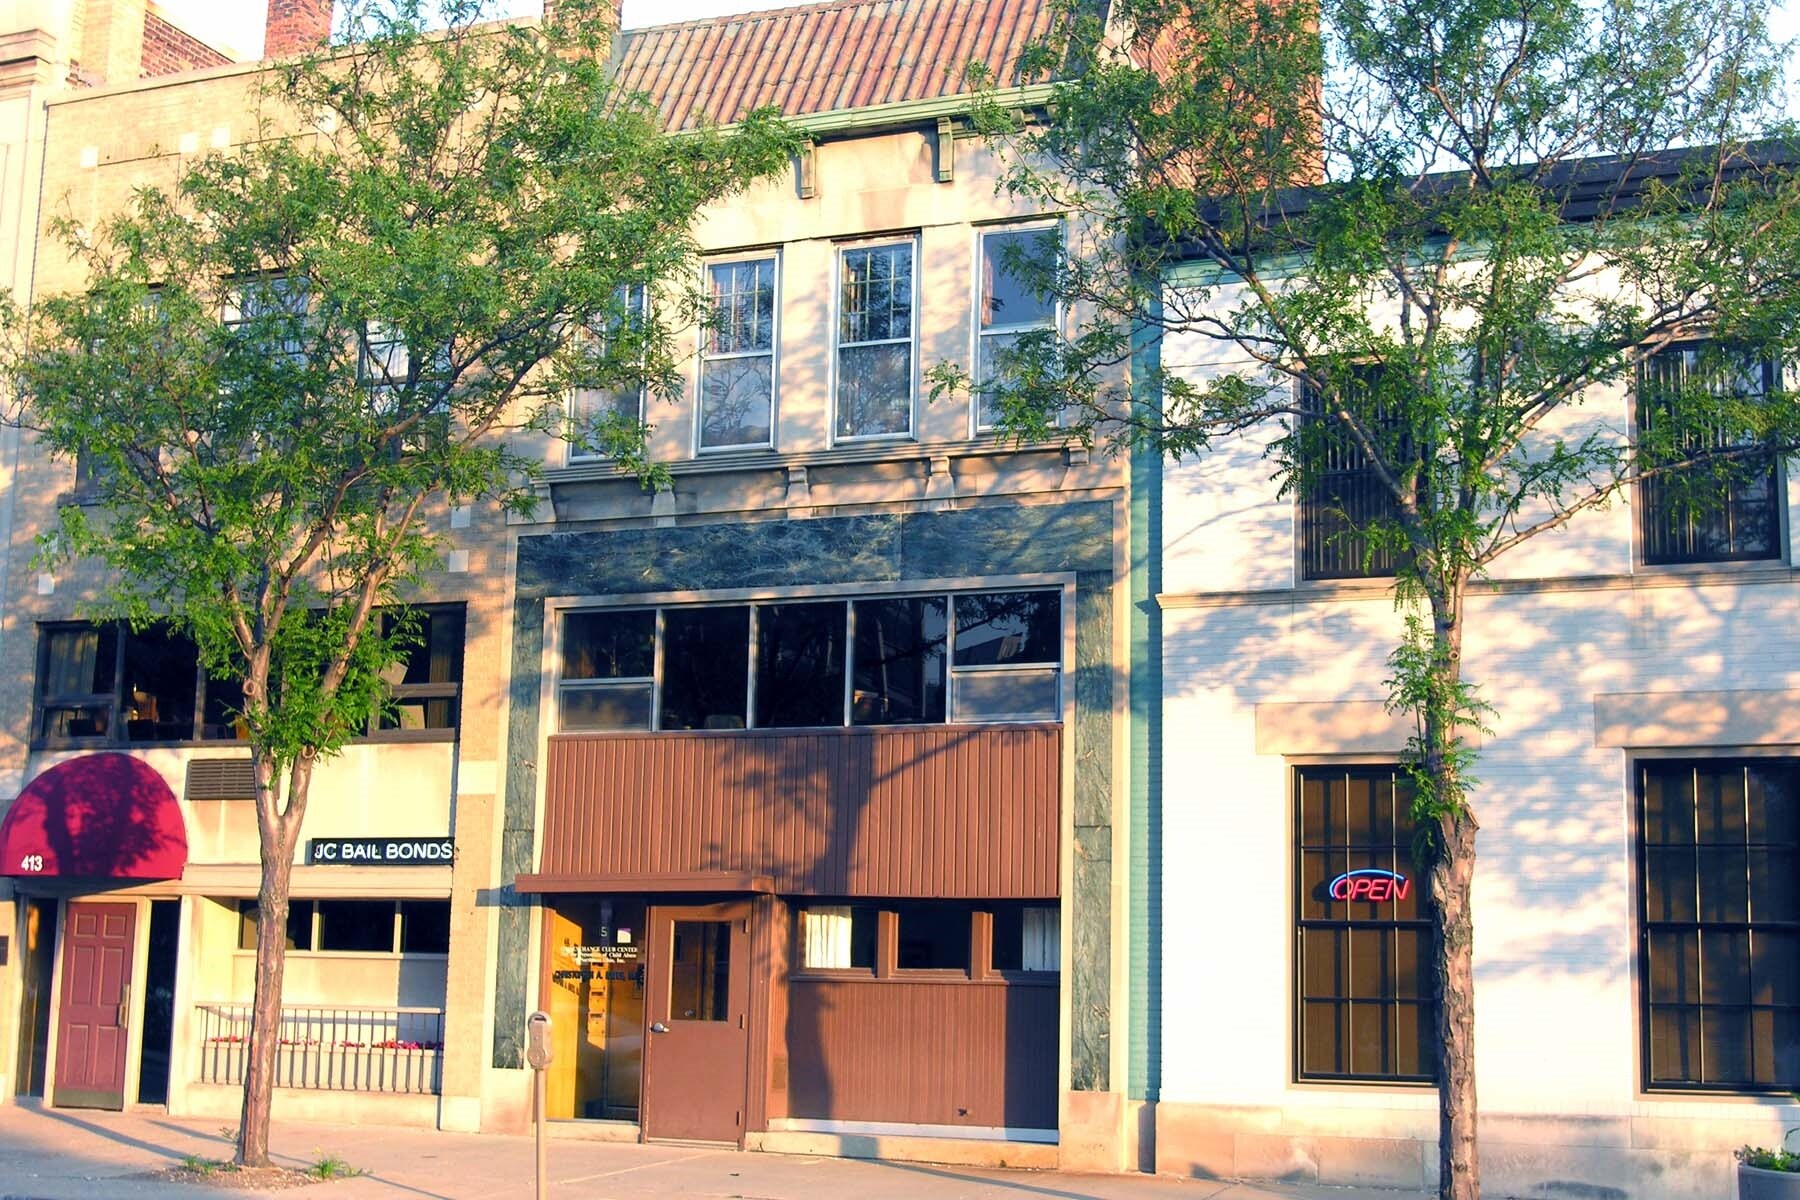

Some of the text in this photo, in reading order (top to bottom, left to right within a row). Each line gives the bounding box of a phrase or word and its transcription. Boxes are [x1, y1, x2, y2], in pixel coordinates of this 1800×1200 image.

[314, 843, 453, 859] JC BAIL BONDS
[20, 854, 43, 872] 413
[1333, 878, 1409, 900] OPEN
